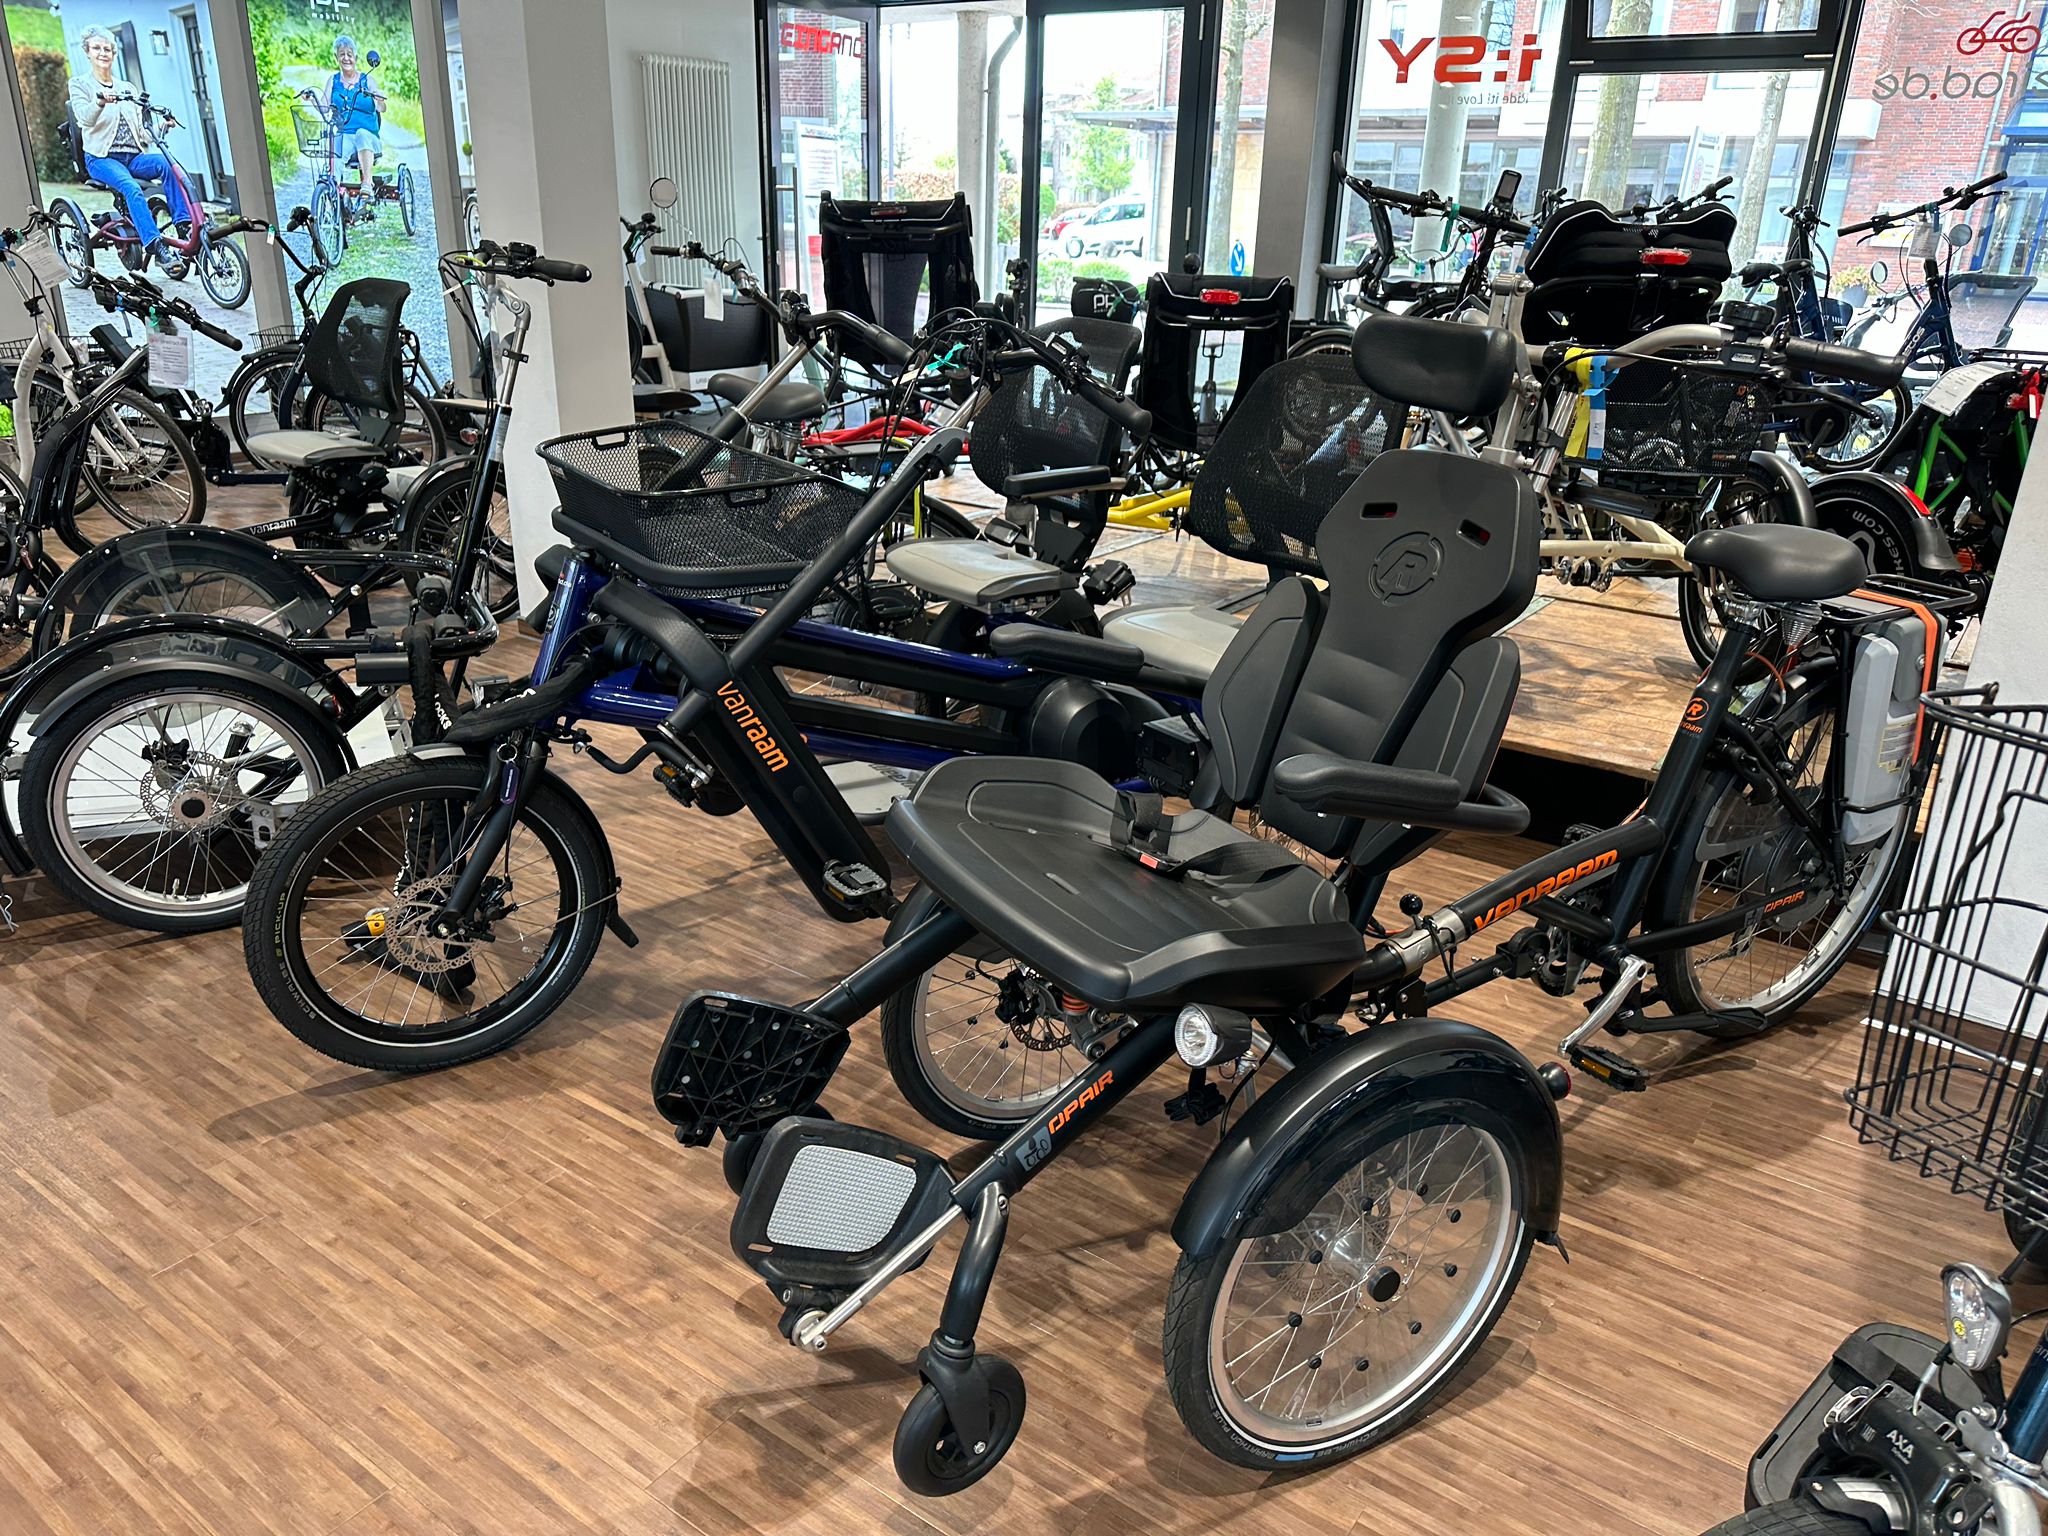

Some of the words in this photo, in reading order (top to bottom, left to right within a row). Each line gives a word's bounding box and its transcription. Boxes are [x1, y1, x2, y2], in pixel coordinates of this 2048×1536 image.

[249, 518, 297, 535] vanraam
[716, 680, 789, 772] vanraam
[1047, 1069, 1115, 1135] OPAIR
[1211, 1411, 1231, 1433] PLUS
[1230, 1435, 1275, 1460] MARATHON
[1316, 1427, 1381, 1458] SCHWALBE
[1885, 1429, 1915, 1459] AXA
